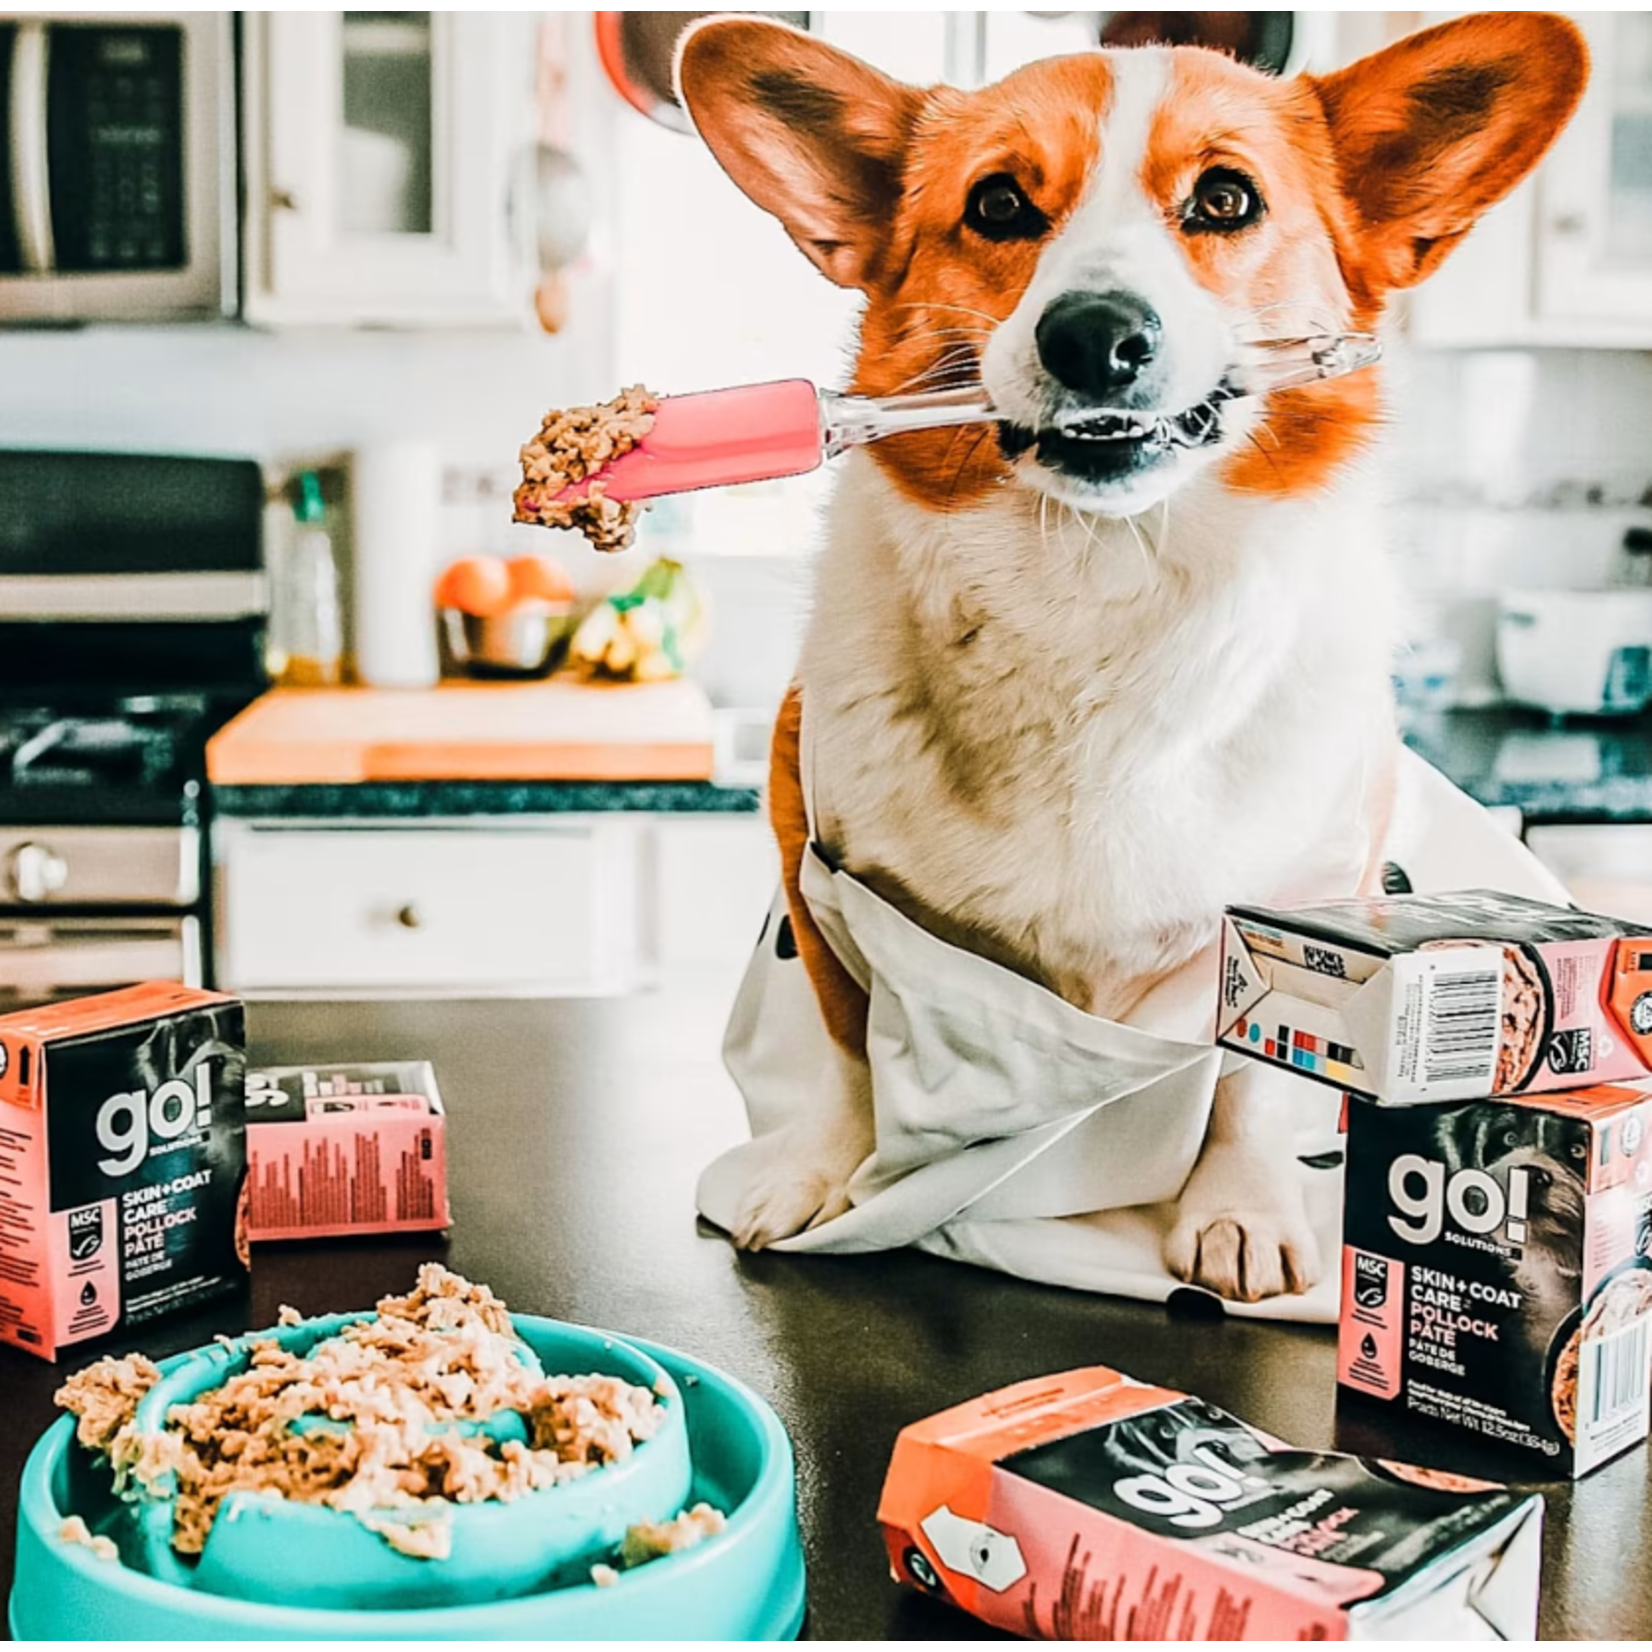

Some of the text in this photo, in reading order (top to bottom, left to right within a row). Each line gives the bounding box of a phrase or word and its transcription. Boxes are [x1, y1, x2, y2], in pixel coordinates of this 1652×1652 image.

[1574, 1029, 1590, 1071] MSC
[96, 1062, 212, 1177] go!
[123, 1199, 168, 1225] CARE
[1386, 1153, 1529, 1245] go!
[70, 1207, 100, 1228] MSC
[124, 1206, 197, 1241] POLLOCK
[1444, 1231, 1512, 1257] SOLUTIONS
[1357, 1256, 1386, 1278] MSC
[1411, 1284, 1462, 1312] CARE
[1411, 1301, 1499, 1341] POLLOCK
[1113, 1447, 1270, 1528] go!
